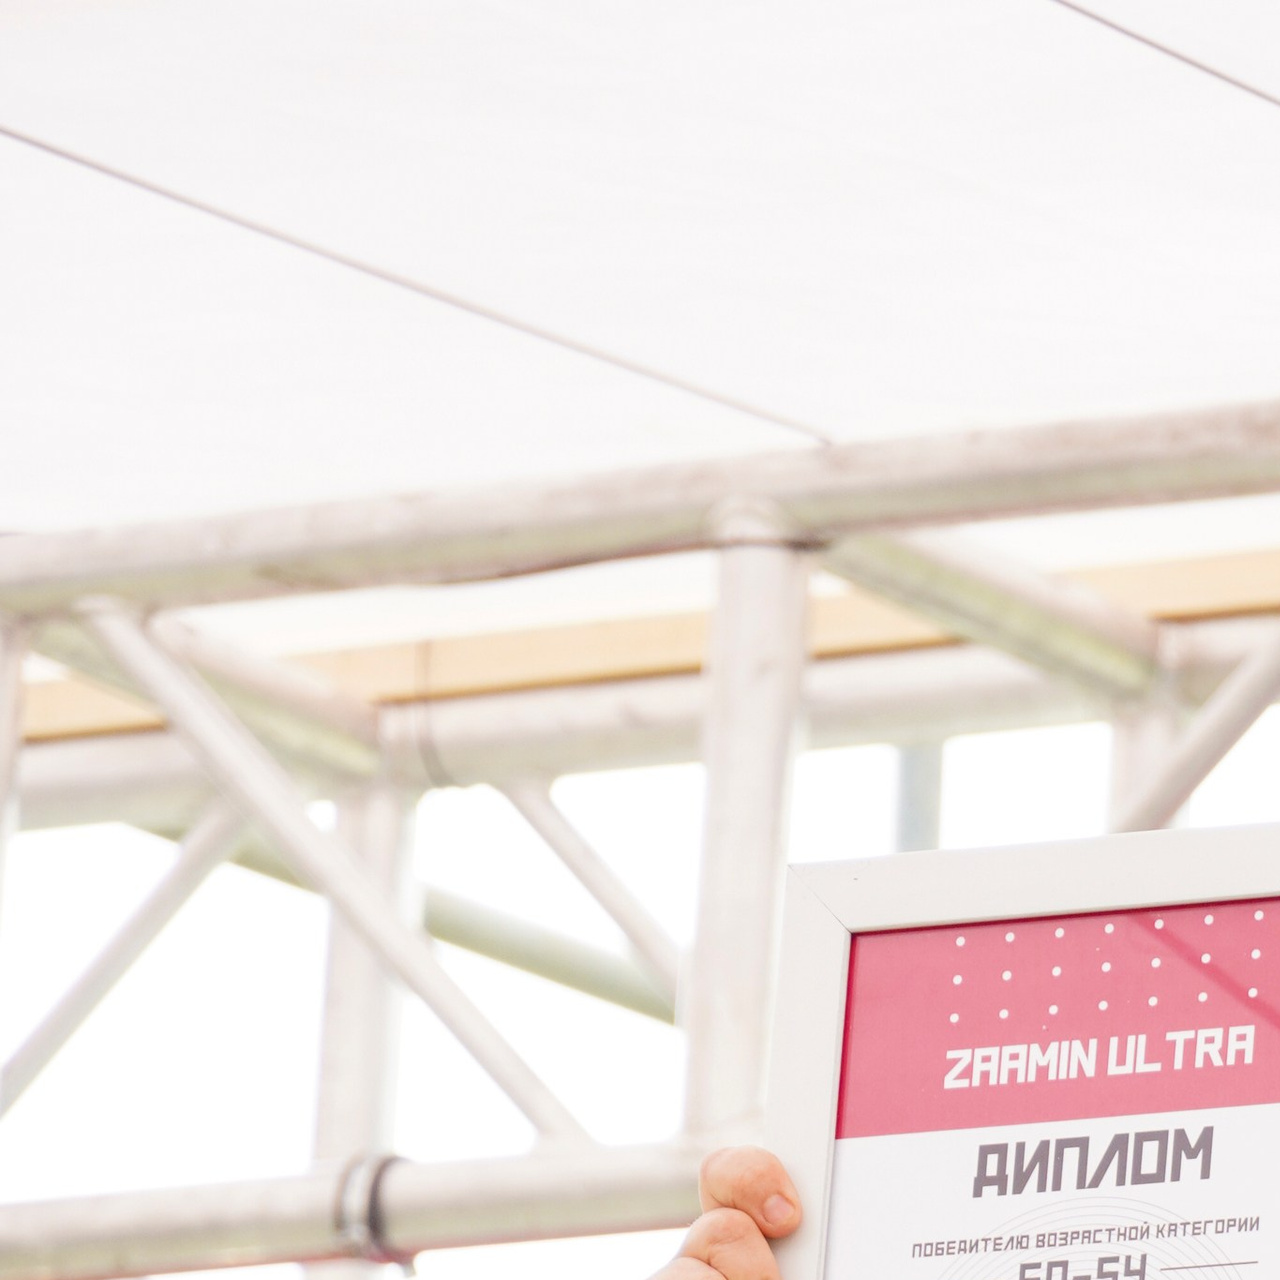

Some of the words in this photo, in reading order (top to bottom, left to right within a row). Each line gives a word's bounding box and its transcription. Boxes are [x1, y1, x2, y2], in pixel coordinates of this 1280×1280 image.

[943, 1038, 1097, 1089] ZAAMIN
[1106, 1024, 1256, 1076] ULTRA
[972, 1125, 1214, 1198] ДИПЛОМ
[911, 1233, 1030, 1258] ПОБЕДИТЕЛЮ
[1035, 1220, 1151, 1249] ВОЗРАСТНОЙ
[1156, 1216, 1260, 1239] КАТЕГОРИИ
